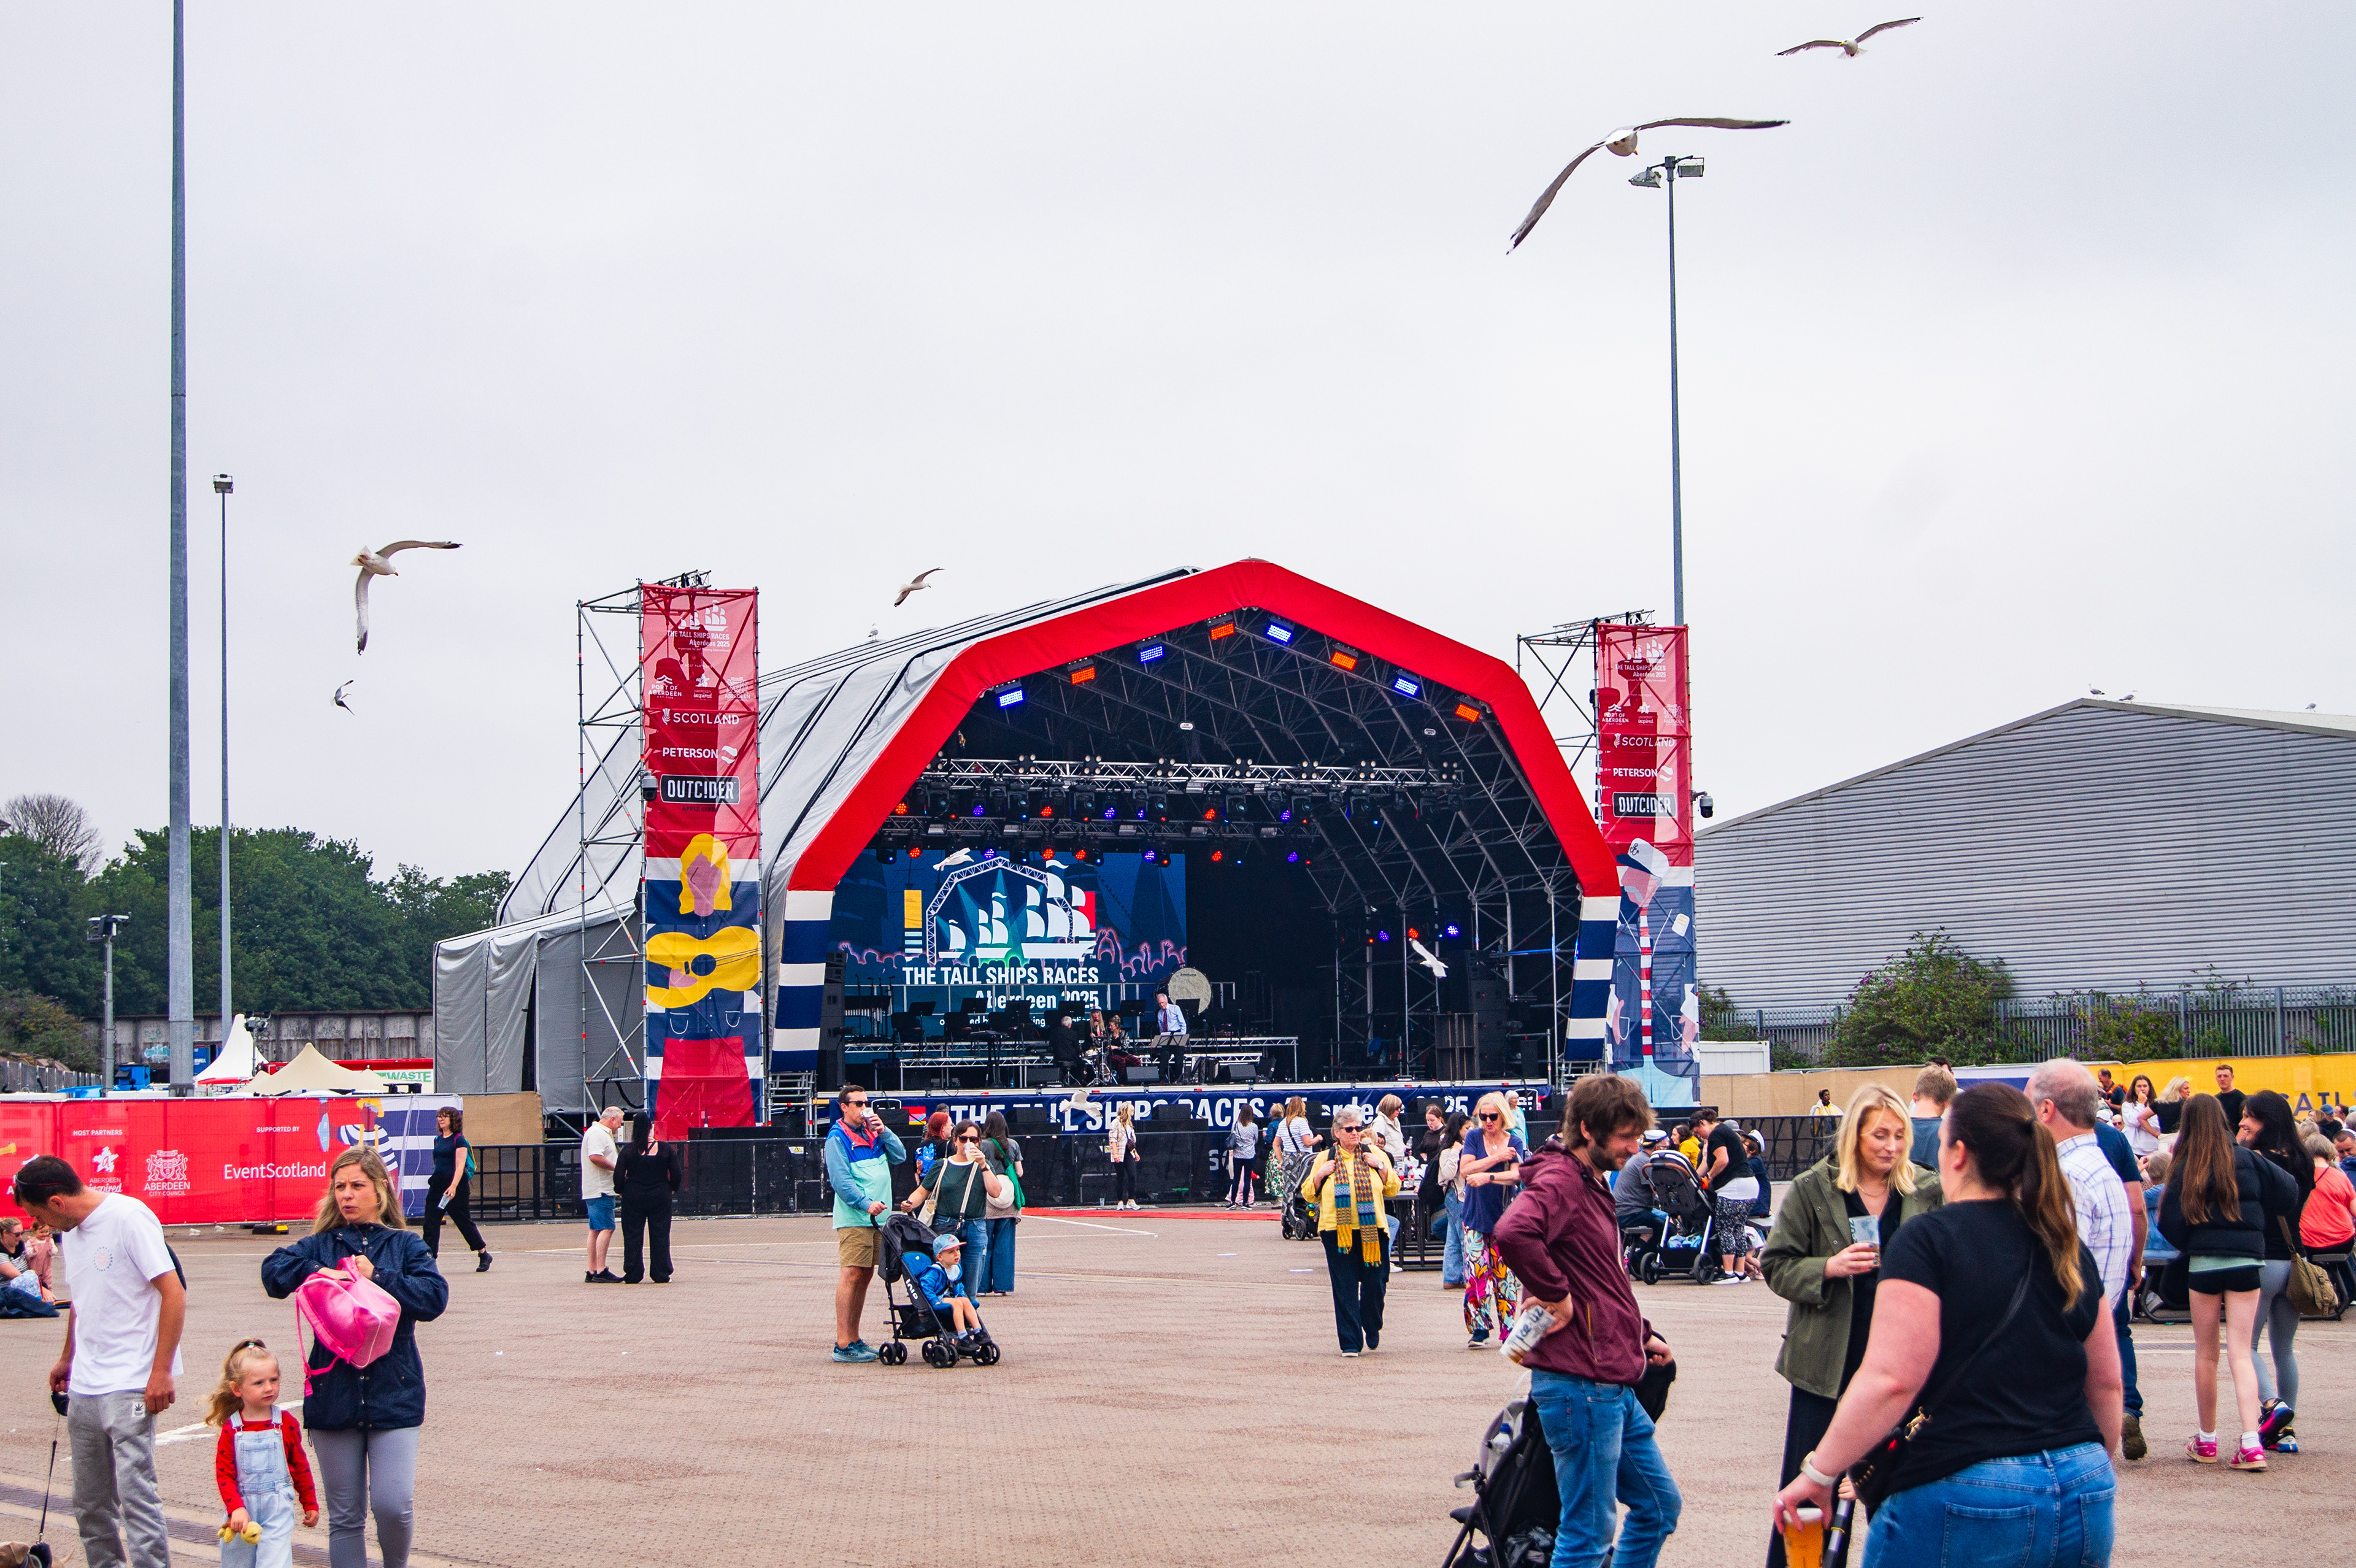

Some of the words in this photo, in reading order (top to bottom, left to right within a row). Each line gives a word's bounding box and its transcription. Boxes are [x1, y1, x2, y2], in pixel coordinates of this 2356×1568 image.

[673, 712, 740, 725] SCOTLAND
[1622, 737, 1676, 747] SCOTLAND
[662, 747, 718, 759] PETERSON
[1613, 767, 1658, 777] PETERSON
[902, 967, 937, 985] THE
[941, 967, 982, 985] TALL
[986, 967, 1038, 985] SHIPS
[1042, 967, 1099, 985] RACES
[387, 1071, 432, 1082] WASTE
[225, 1161, 326, 1179] EventScotland
[144, 1182, 191, 1191] ABERDEEN
